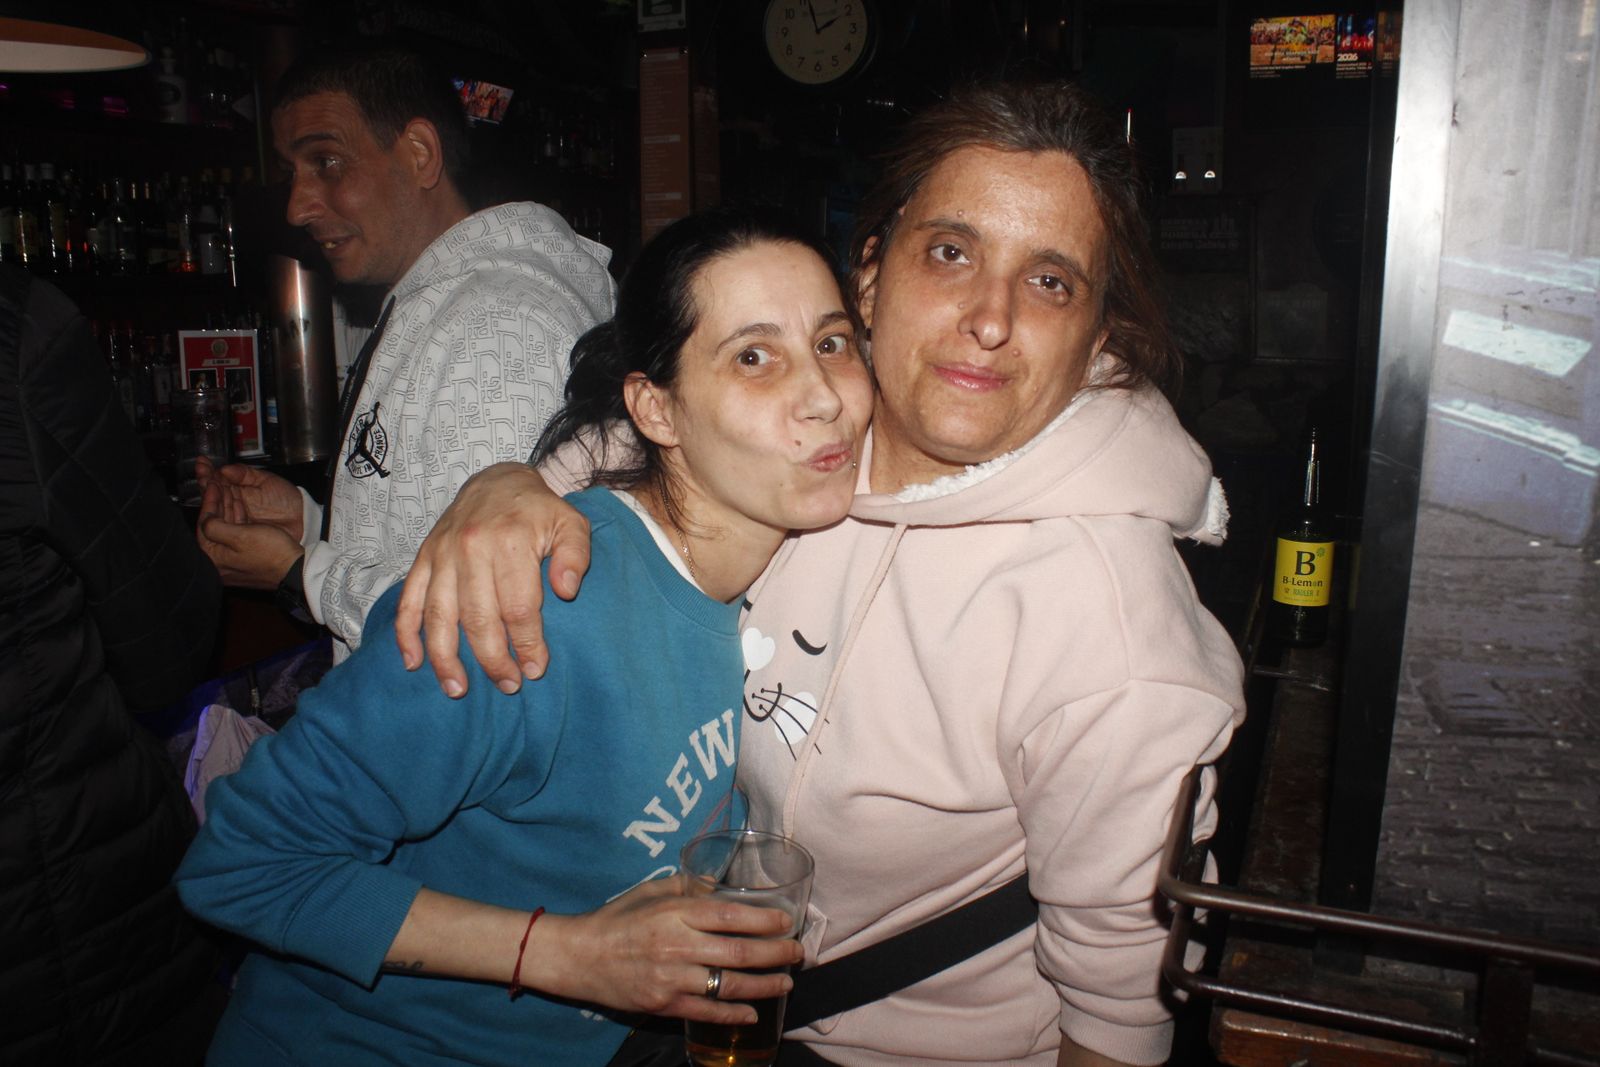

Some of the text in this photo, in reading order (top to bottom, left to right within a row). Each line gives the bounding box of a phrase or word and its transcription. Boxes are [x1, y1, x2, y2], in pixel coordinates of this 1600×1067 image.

[785, 8, 795, 19] 10
[844, 4, 853, 16] 2
[781, 27, 789, 38] 9
[849, 22, 857, 34] 3
[786, 44, 793, 56] 8
[843, 42, 851, 53] 4
[797, 56, 806, 68] 7
[814, 60, 822, 72] 6
[831, 55, 839, 67] 5
[374, 428, 385, 460] FRANCE
[1294, 550, 1316, 575] B
[1282, 575, 1323, 587] B-Lemon
[623, 708, 737, 858] NEW
